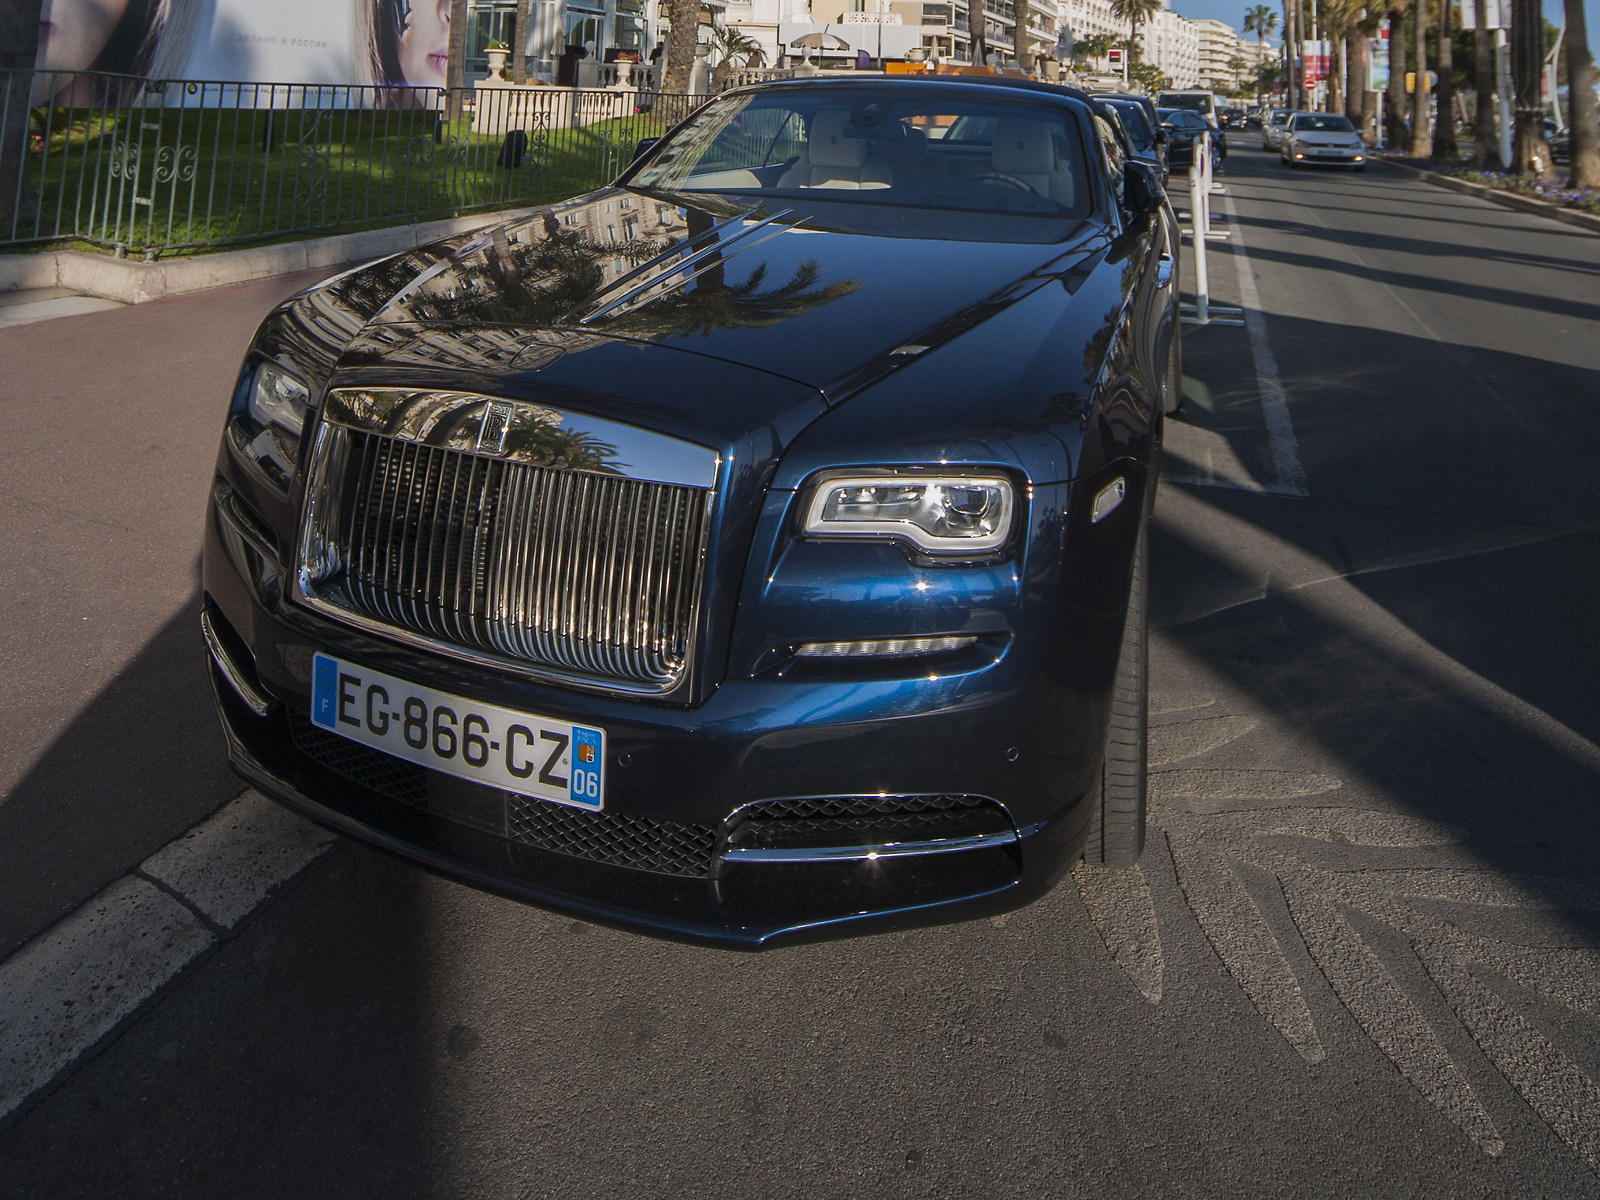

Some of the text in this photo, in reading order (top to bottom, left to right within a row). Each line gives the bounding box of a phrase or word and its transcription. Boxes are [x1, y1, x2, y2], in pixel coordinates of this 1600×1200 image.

[321, 698, 329, 712] F
[338, 672, 569, 789] EG-866-CZ
[573, 768, 599, 798] 06
